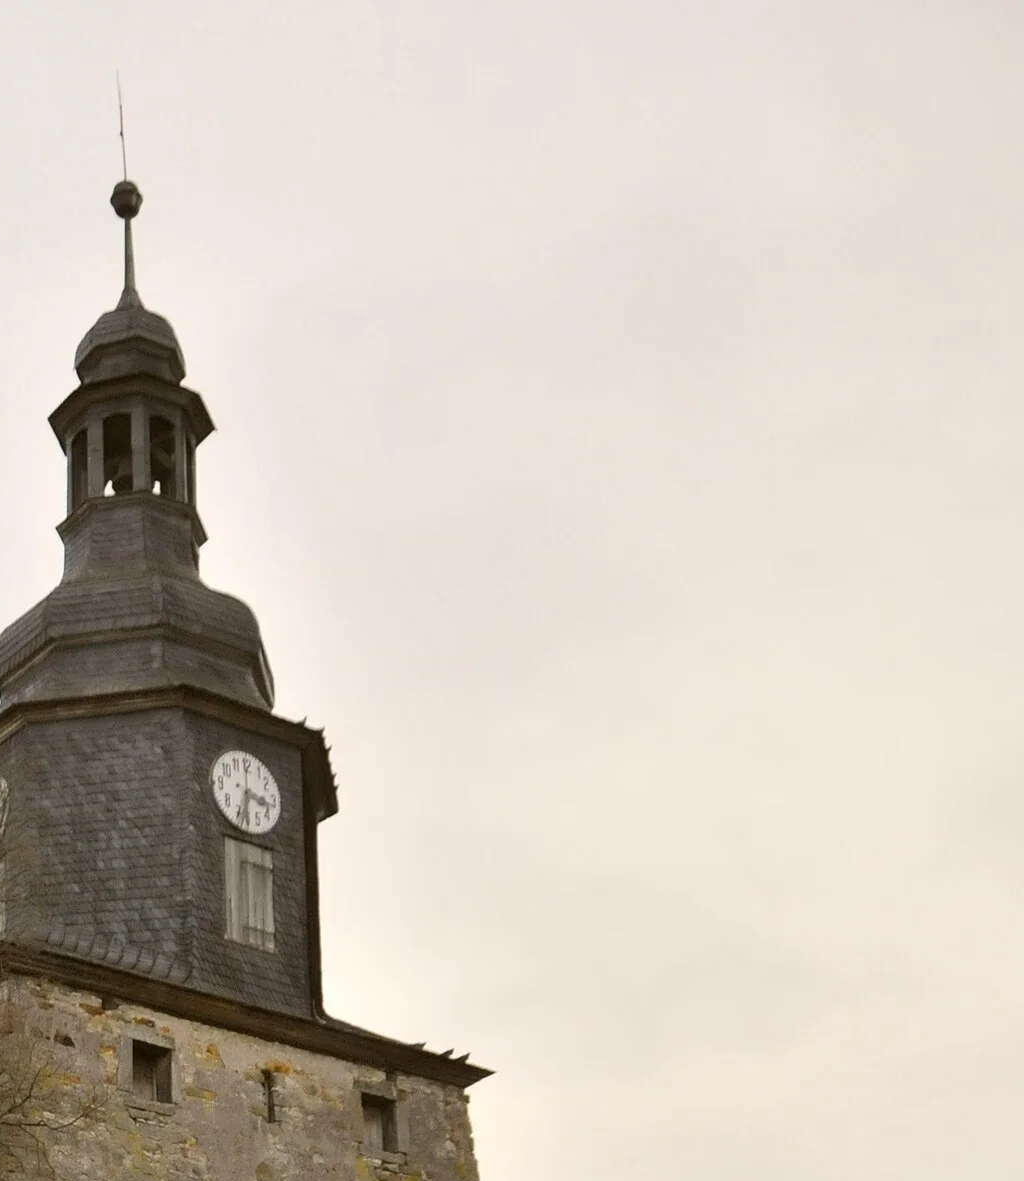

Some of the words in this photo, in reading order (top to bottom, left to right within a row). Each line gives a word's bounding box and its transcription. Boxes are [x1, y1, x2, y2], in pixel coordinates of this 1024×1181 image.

[222, 762, 231, 778] 10
[232, 757, 239, 772] 11
[242, 757, 252, 773] 12
[257, 766, 261, 780] 1
[218, 775, 224, 790] 9
[263, 776, 269, 790] 2
[224, 793, 231, 807] 8
[270, 794, 276, 808] 3
[236, 805, 241, 819] 7
[255, 811, 261, 826] 5
[264, 805, 270, 821] 4
